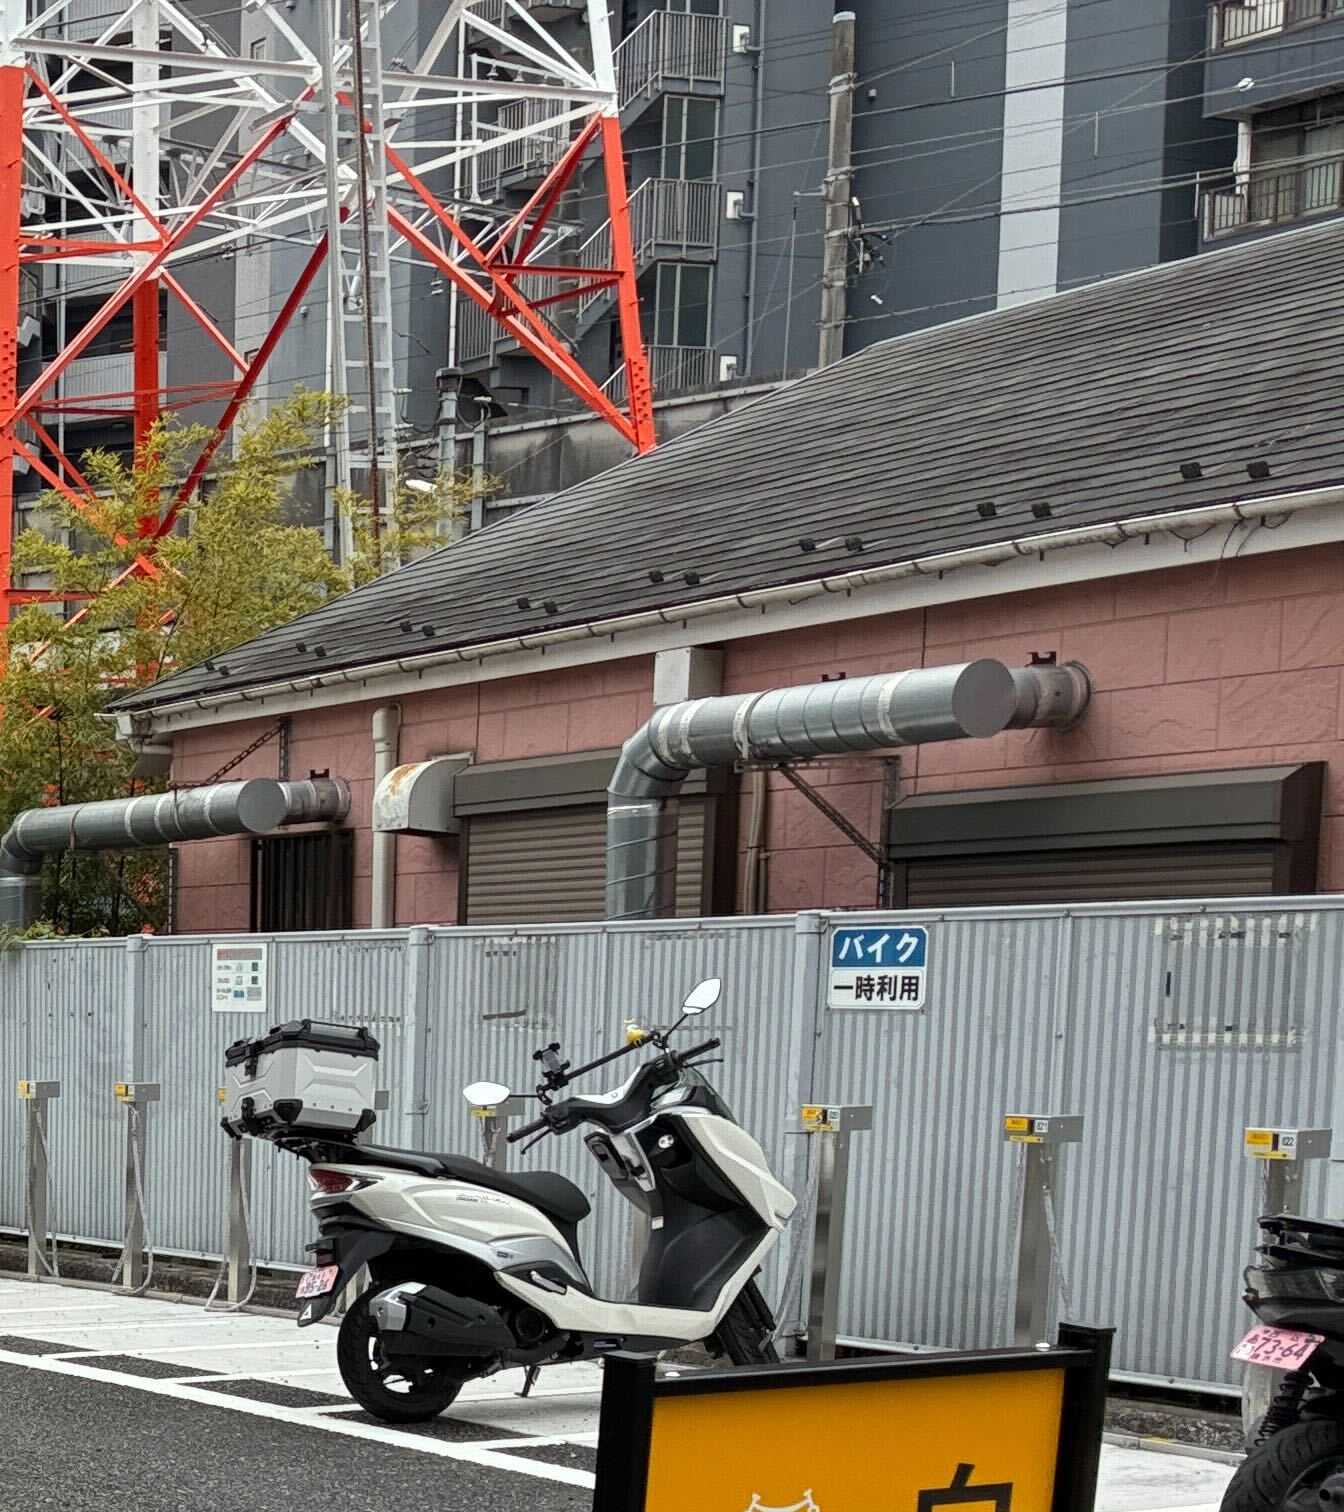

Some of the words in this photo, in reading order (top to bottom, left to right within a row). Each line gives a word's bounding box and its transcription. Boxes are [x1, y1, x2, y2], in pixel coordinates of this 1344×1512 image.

[838, 932, 919, 963] バイク
[833, 974, 920, 1002] 一時利用
